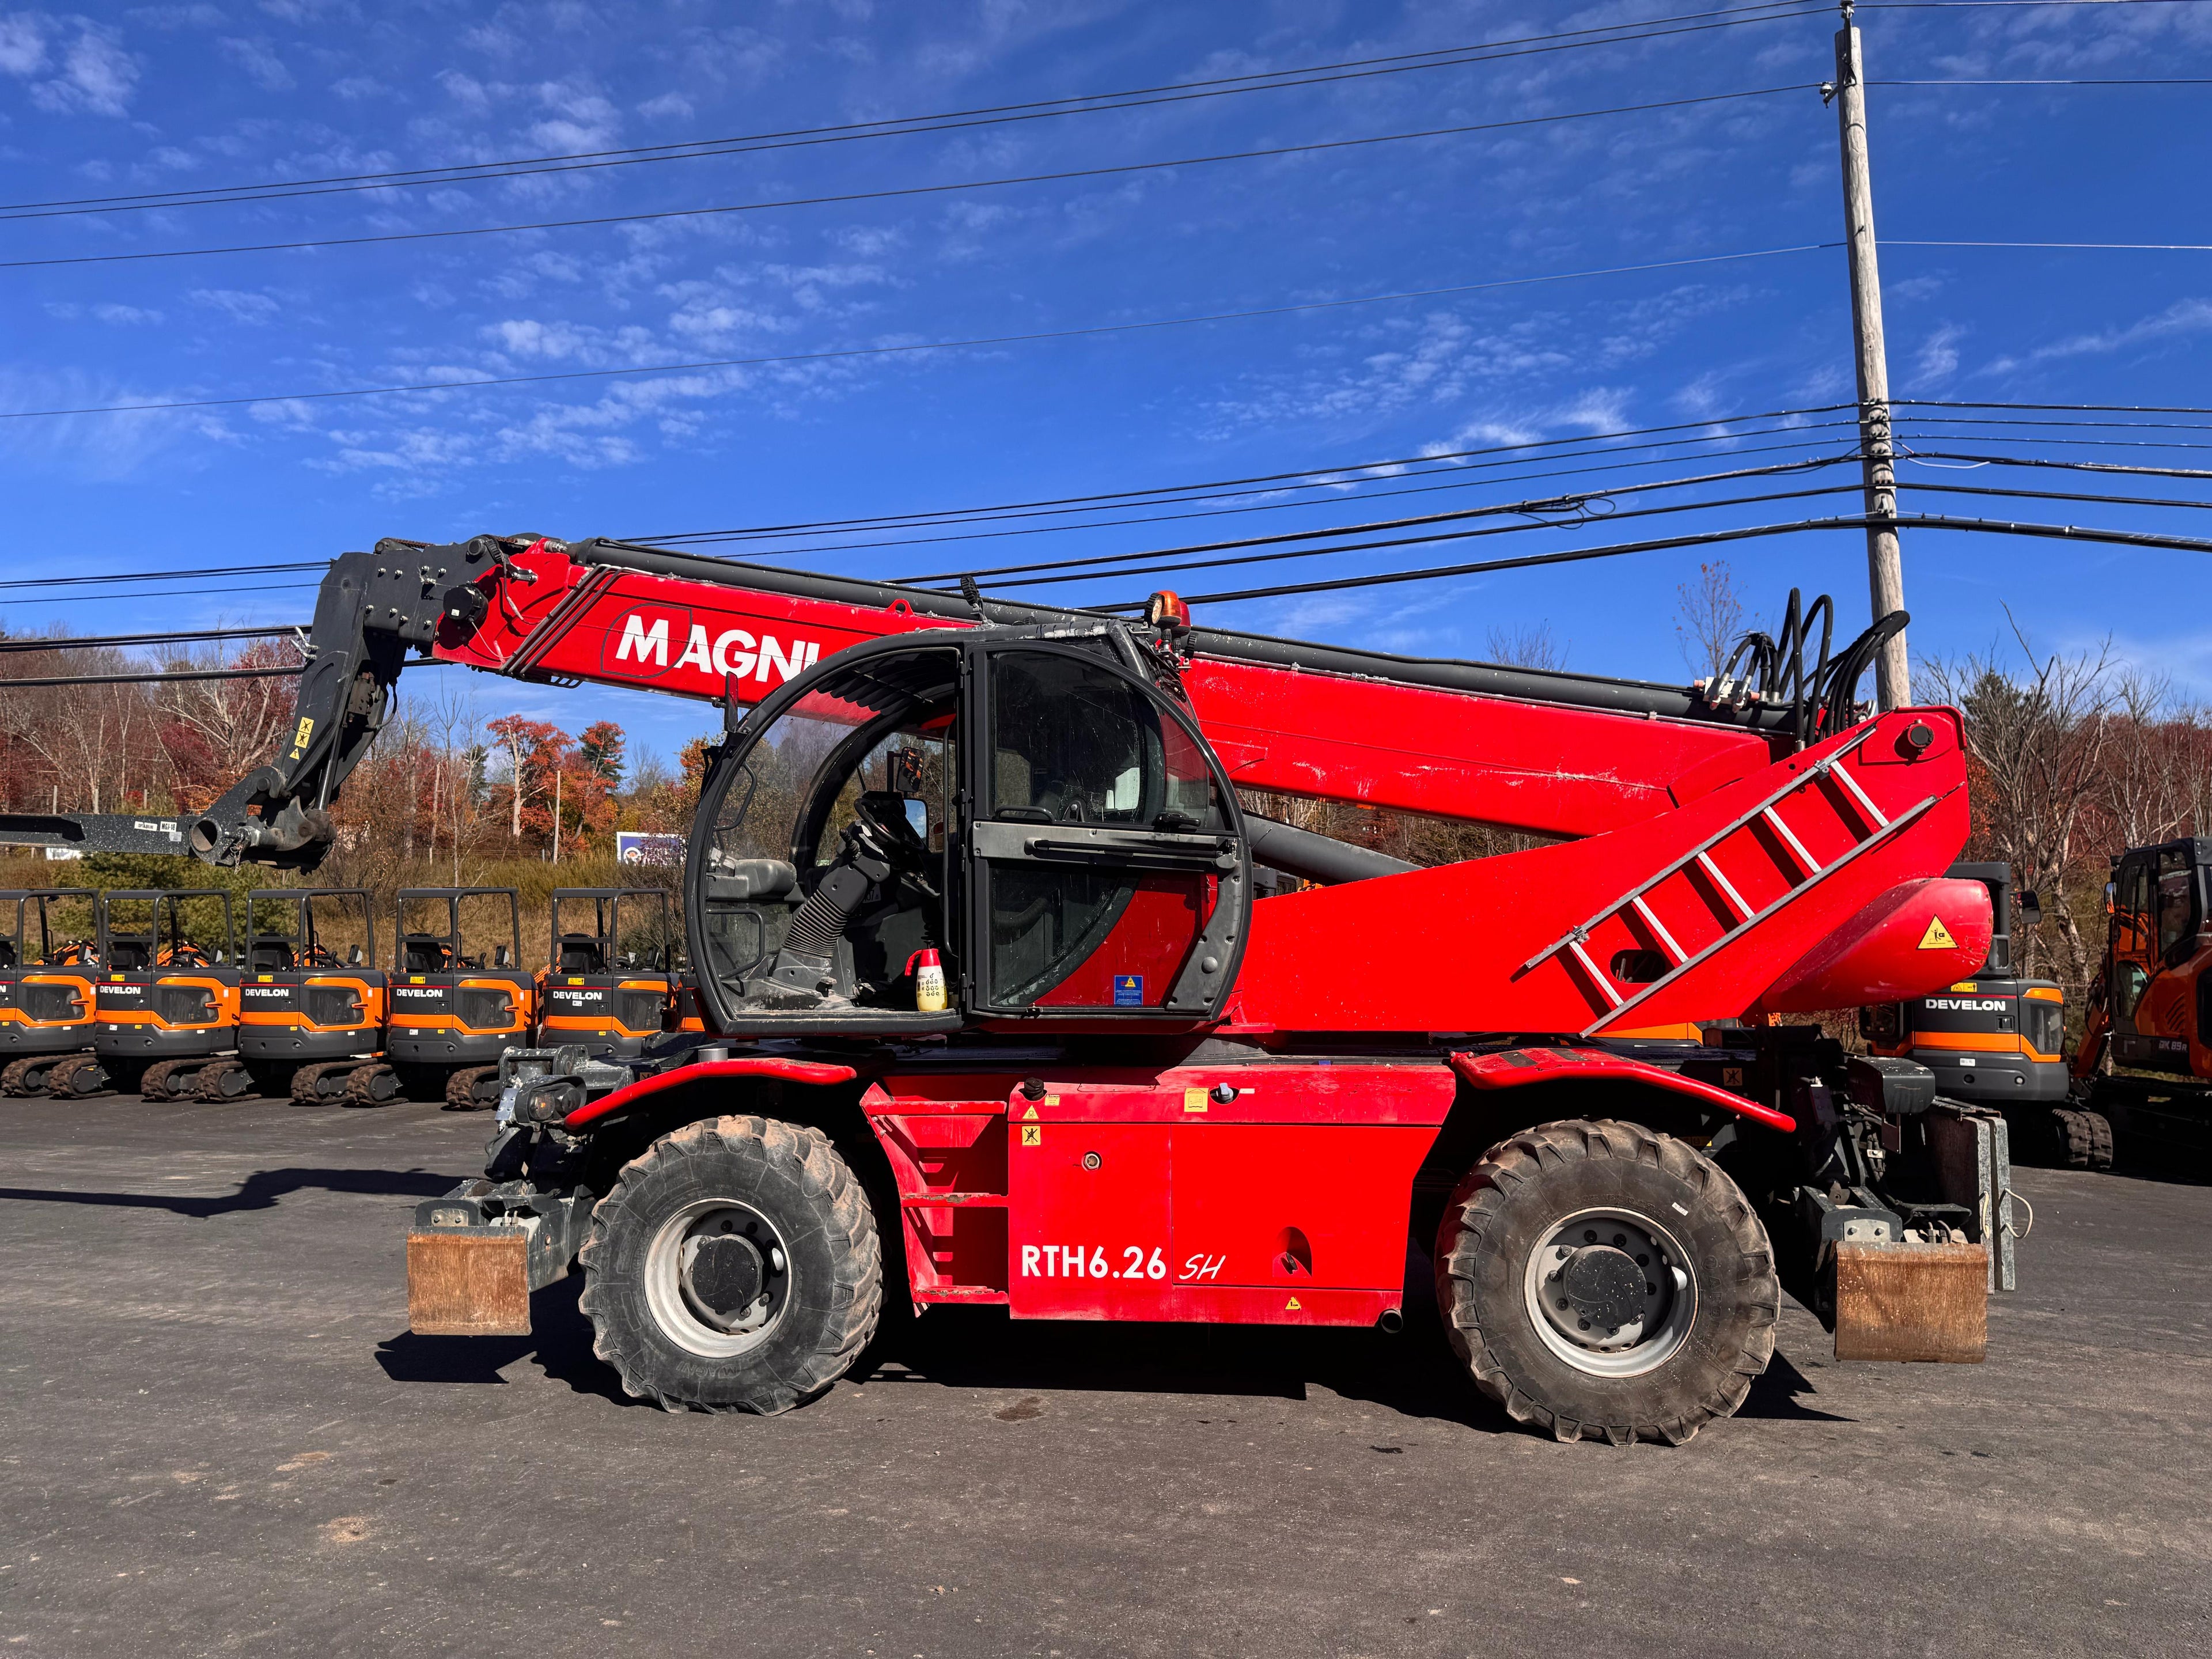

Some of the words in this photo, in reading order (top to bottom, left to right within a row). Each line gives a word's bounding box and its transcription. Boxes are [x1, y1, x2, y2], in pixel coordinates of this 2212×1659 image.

[615, 614, 820, 682] MAGNI
[100, 986, 141, 994] DEVELON
[245, 988, 289, 997] DEVELON
[396, 988, 442, 997] DEVELON
[553, 991, 602, 1000] DEVELON
[1926, 999, 2006, 1011] DEVELON
[1022, 1244, 1166, 1281] RTH6.26
[1179, 1252, 1227, 1281] SH
